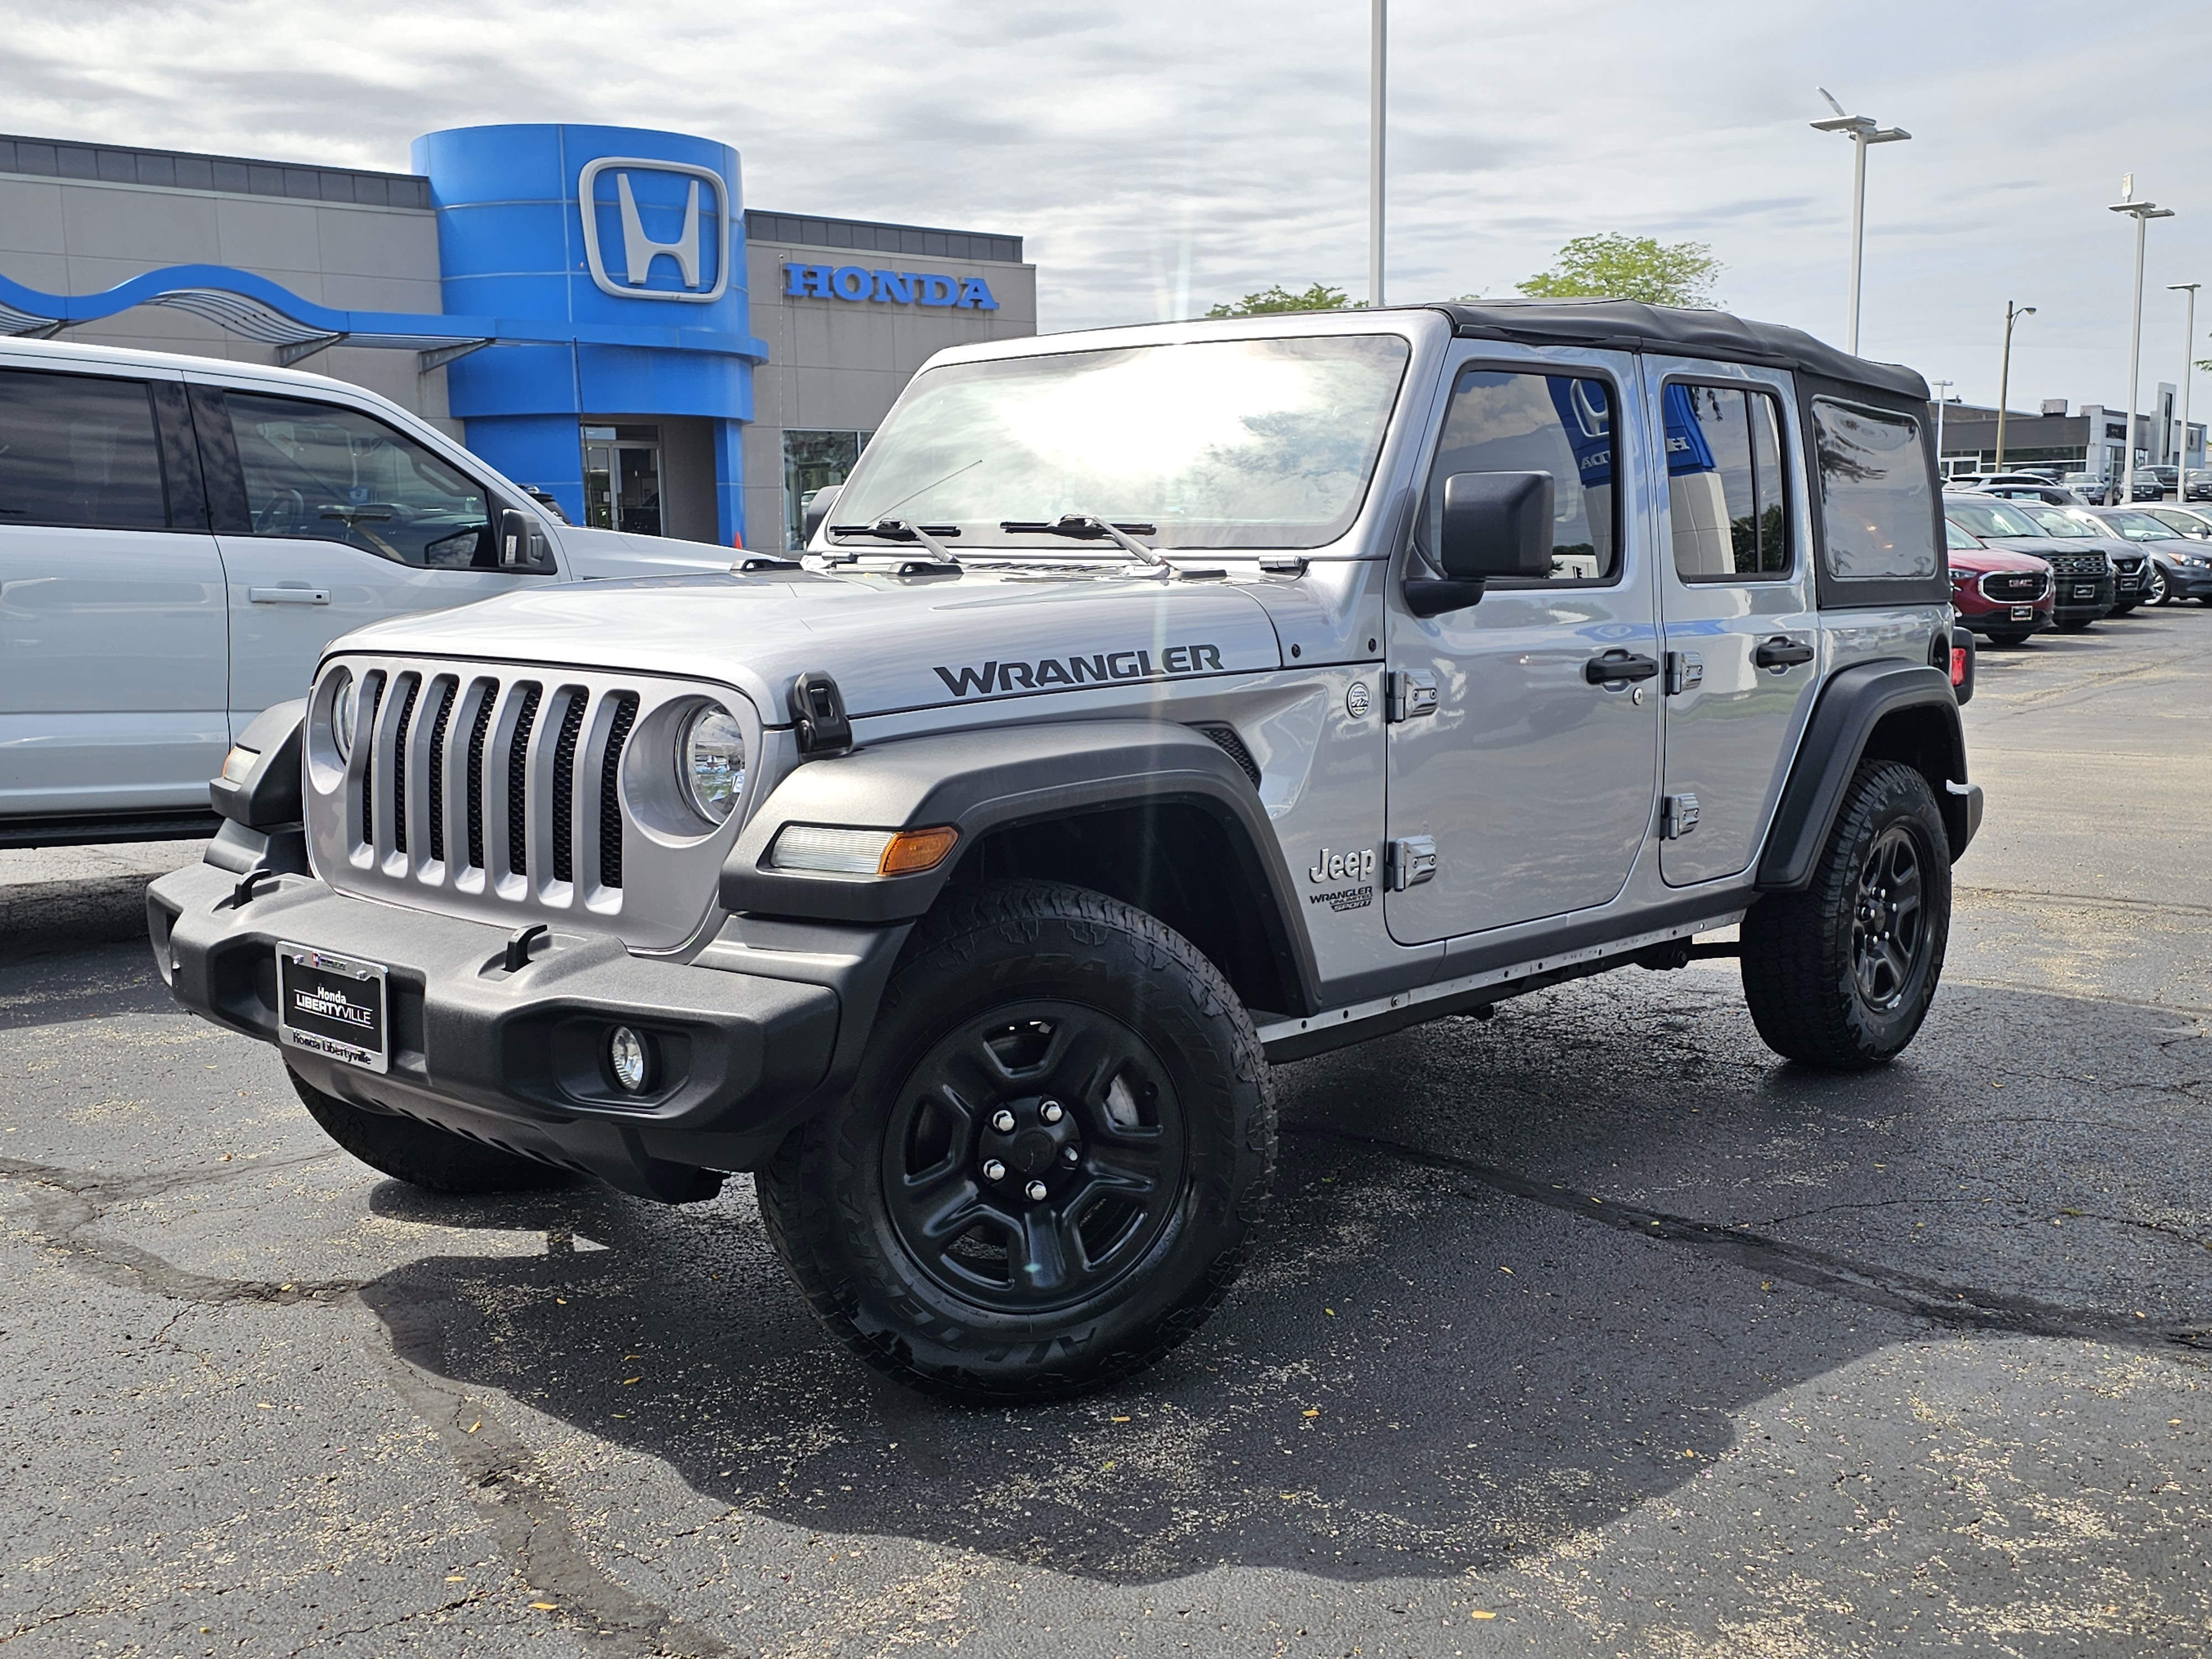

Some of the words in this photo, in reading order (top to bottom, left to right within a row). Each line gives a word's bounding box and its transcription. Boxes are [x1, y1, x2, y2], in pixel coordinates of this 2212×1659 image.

[784, 263, 999, 310] HONDA
[933, 644, 1224, 697] WRANGLER
[1309, 848, 1376, 883] Jeep
[1310, 886, 1373, 904] WRANGLER
[1329, 894, 1373, 905] UNLIMITED
[1333, 900, 1371, 911] SPORT
[296, 994, 371, 1024] LIBERTYVILLE
[317, 985, 346, 1004] Honda
[293, 1031, 320, 1050] Honda
[322, 1040, 371, 1065] Libertyville
